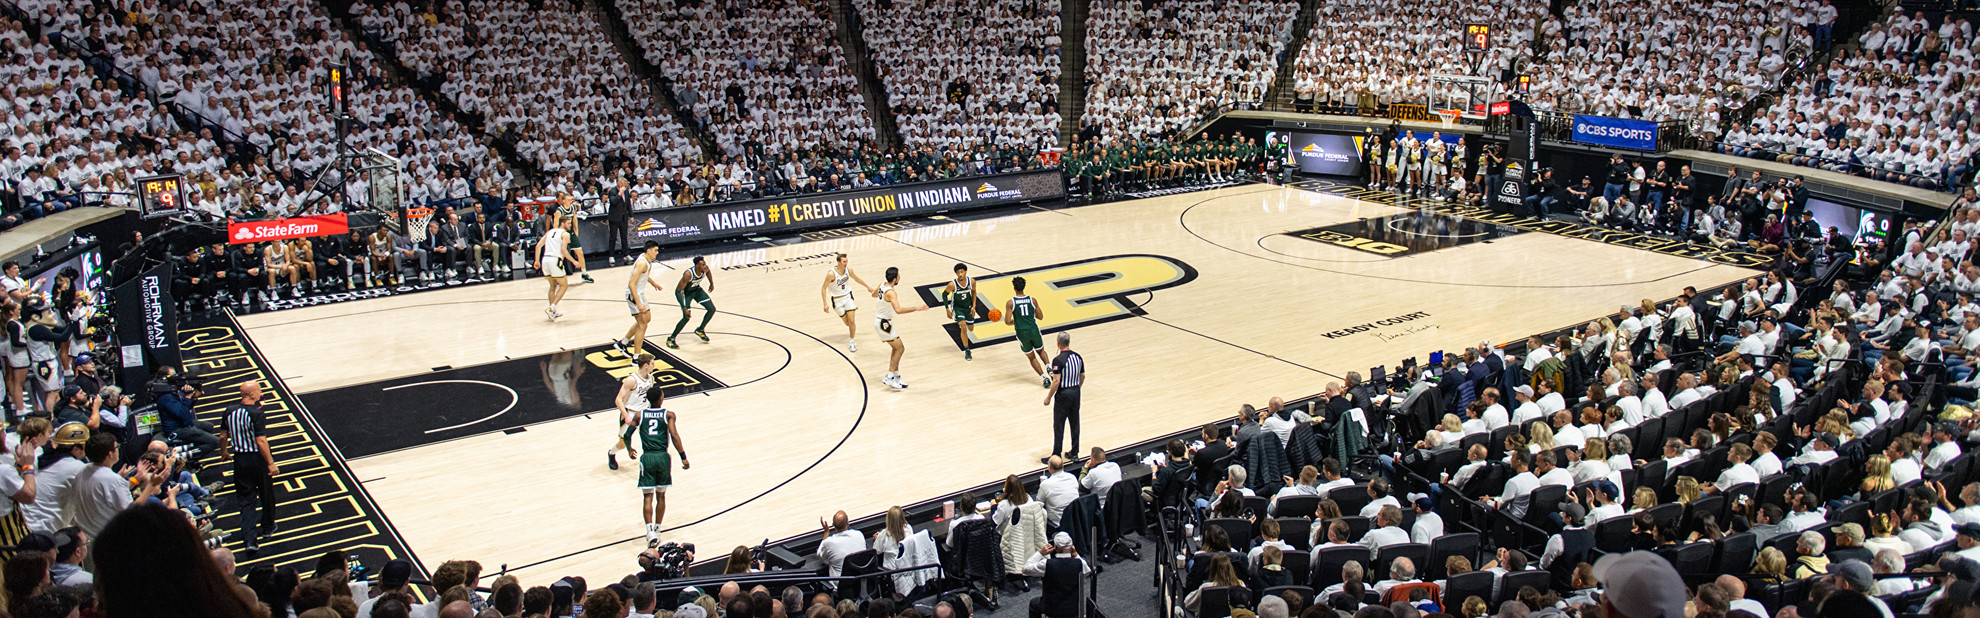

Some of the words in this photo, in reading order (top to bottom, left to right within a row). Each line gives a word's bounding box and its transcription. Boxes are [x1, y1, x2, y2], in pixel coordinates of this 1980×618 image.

[1475, 34, 1486, 49] 9
[1586, 125, 1607, 136] CBS
[1608, 127, 1652, 141] SPORTS
[146, 179, 177, 194] 19:14
[977, 191, 999, 200] PURDUE
[999, 188, 1022, 196] FEDERAL
[161, 193, 174, 207] 9
[707, 208, 766, 232] NAMED
[768, 203, 791, 225] #1
[792, 199, 846, 223] CREDIT
[849, 194, 896, 215] UNION
[898, 191, 913, 210] IN
[915, 186, 972, 207] INDIANA
[638, 228, 668, 238] PURDUE
[668, 225, 701, 234] FEDERAL
[1880, 218, 1890, 231] 0
[721, 259, 779, 271] KEADY
[141, 279, 153, 323] AUTOMOTIVE
[144, 275, 169, 348] ROHRMAN
[1019, 303, 1030, 316] 11
[1320, 322, 1379, 340] KEADY
[1375, 311, 1432, 327] COURT
[146, 325, 156, 349] GROUP
[648, 418, 659, 436] 2
